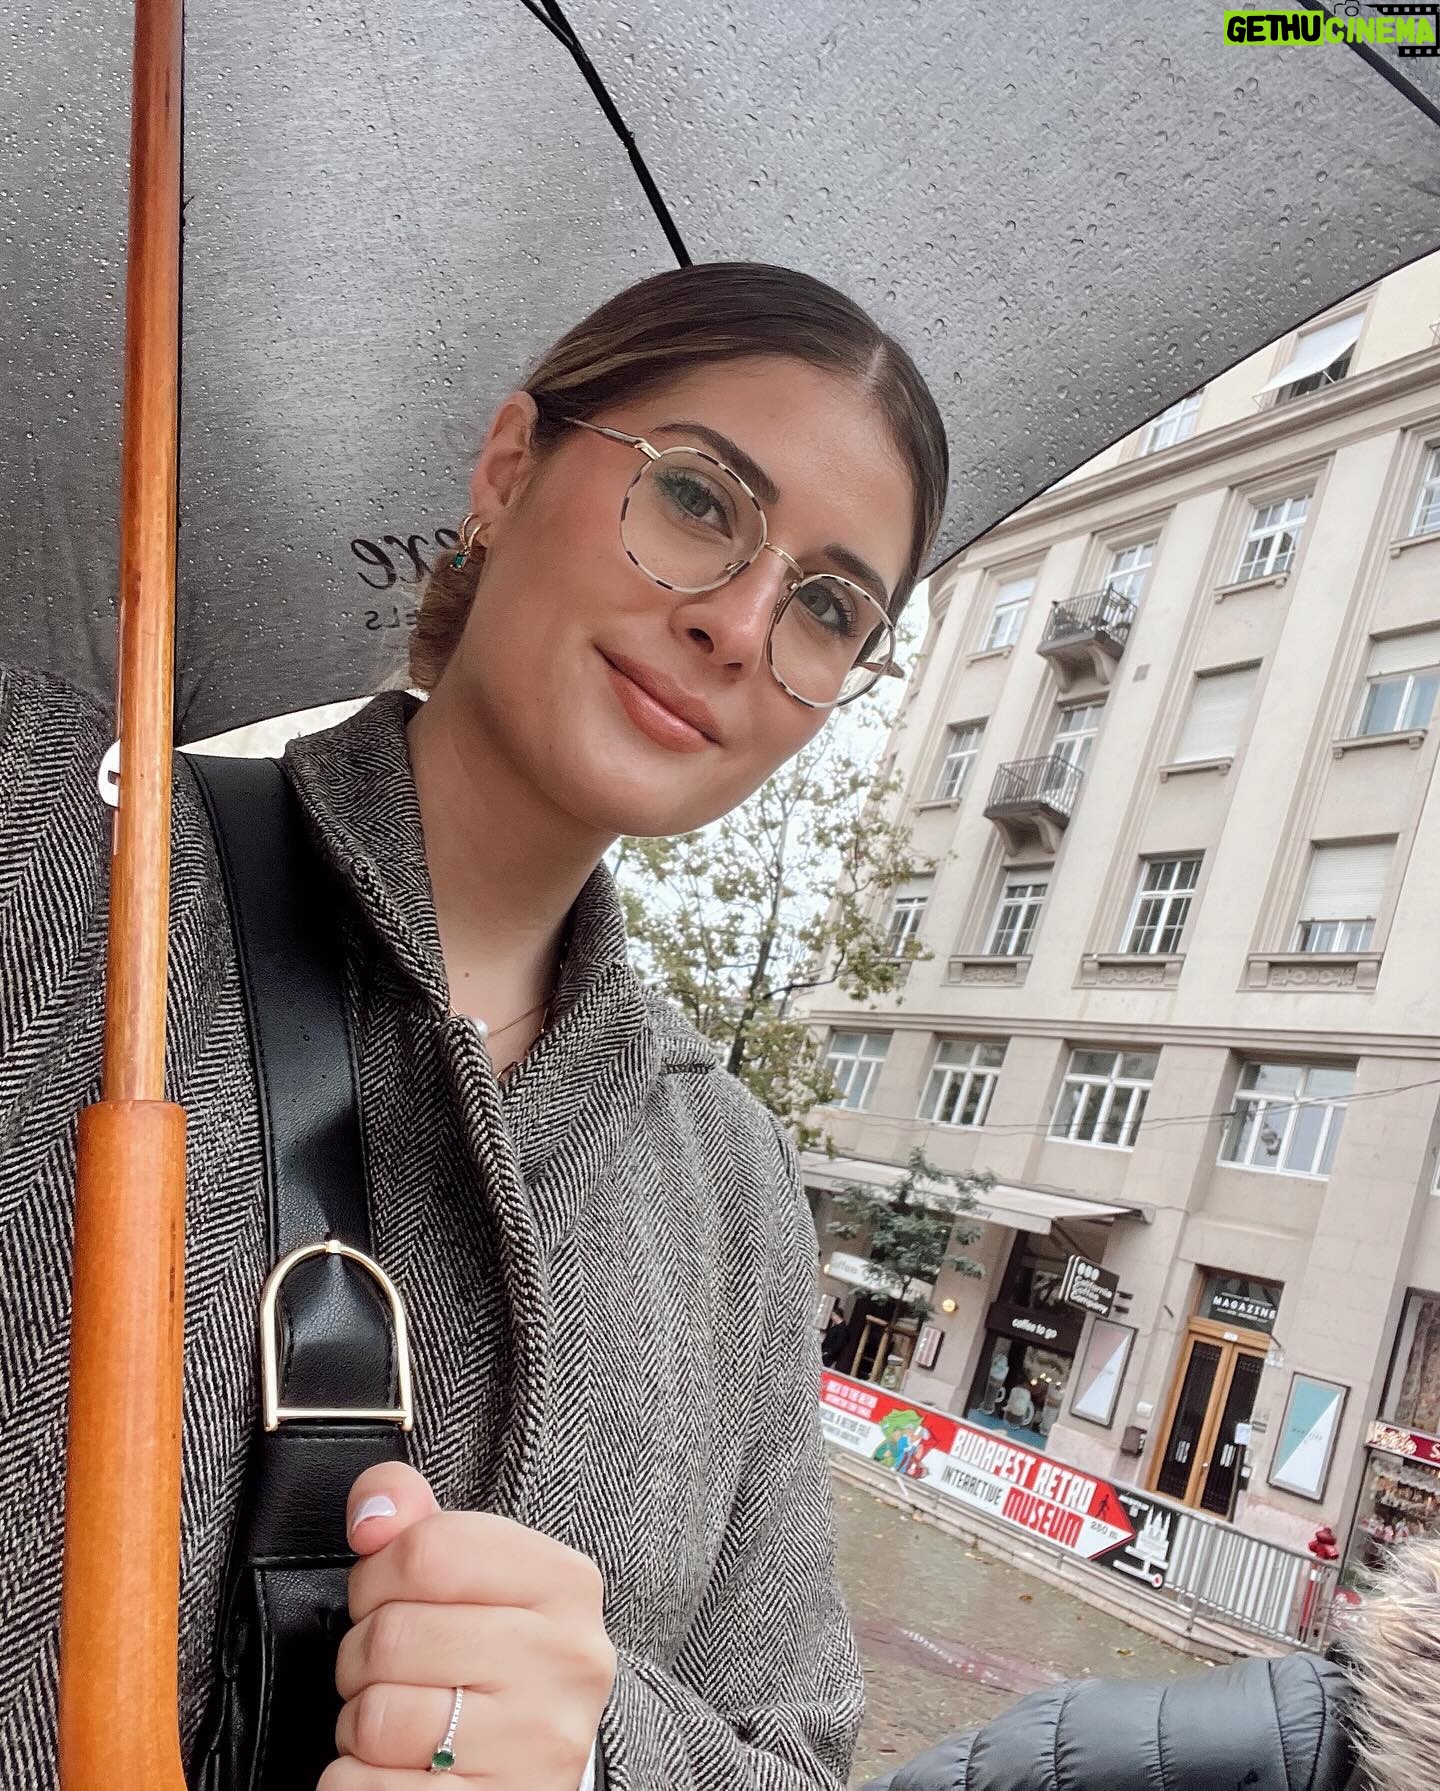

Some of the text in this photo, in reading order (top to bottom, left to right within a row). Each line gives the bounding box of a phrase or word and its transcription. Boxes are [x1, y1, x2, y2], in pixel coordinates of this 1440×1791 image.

[1011, 1318, 1057, 1339] coffee to go
[1212, 1295, 1277, 1320] MAGAZINE
[950, 1427, 1037, 1487] BUDAPEST
[1032, 1461, 1098, 1514] RETRO
[941, 1465, 1003, 1506] INTERACTIVE
[1001, 1486, 1085, 1549] MUSEUM
